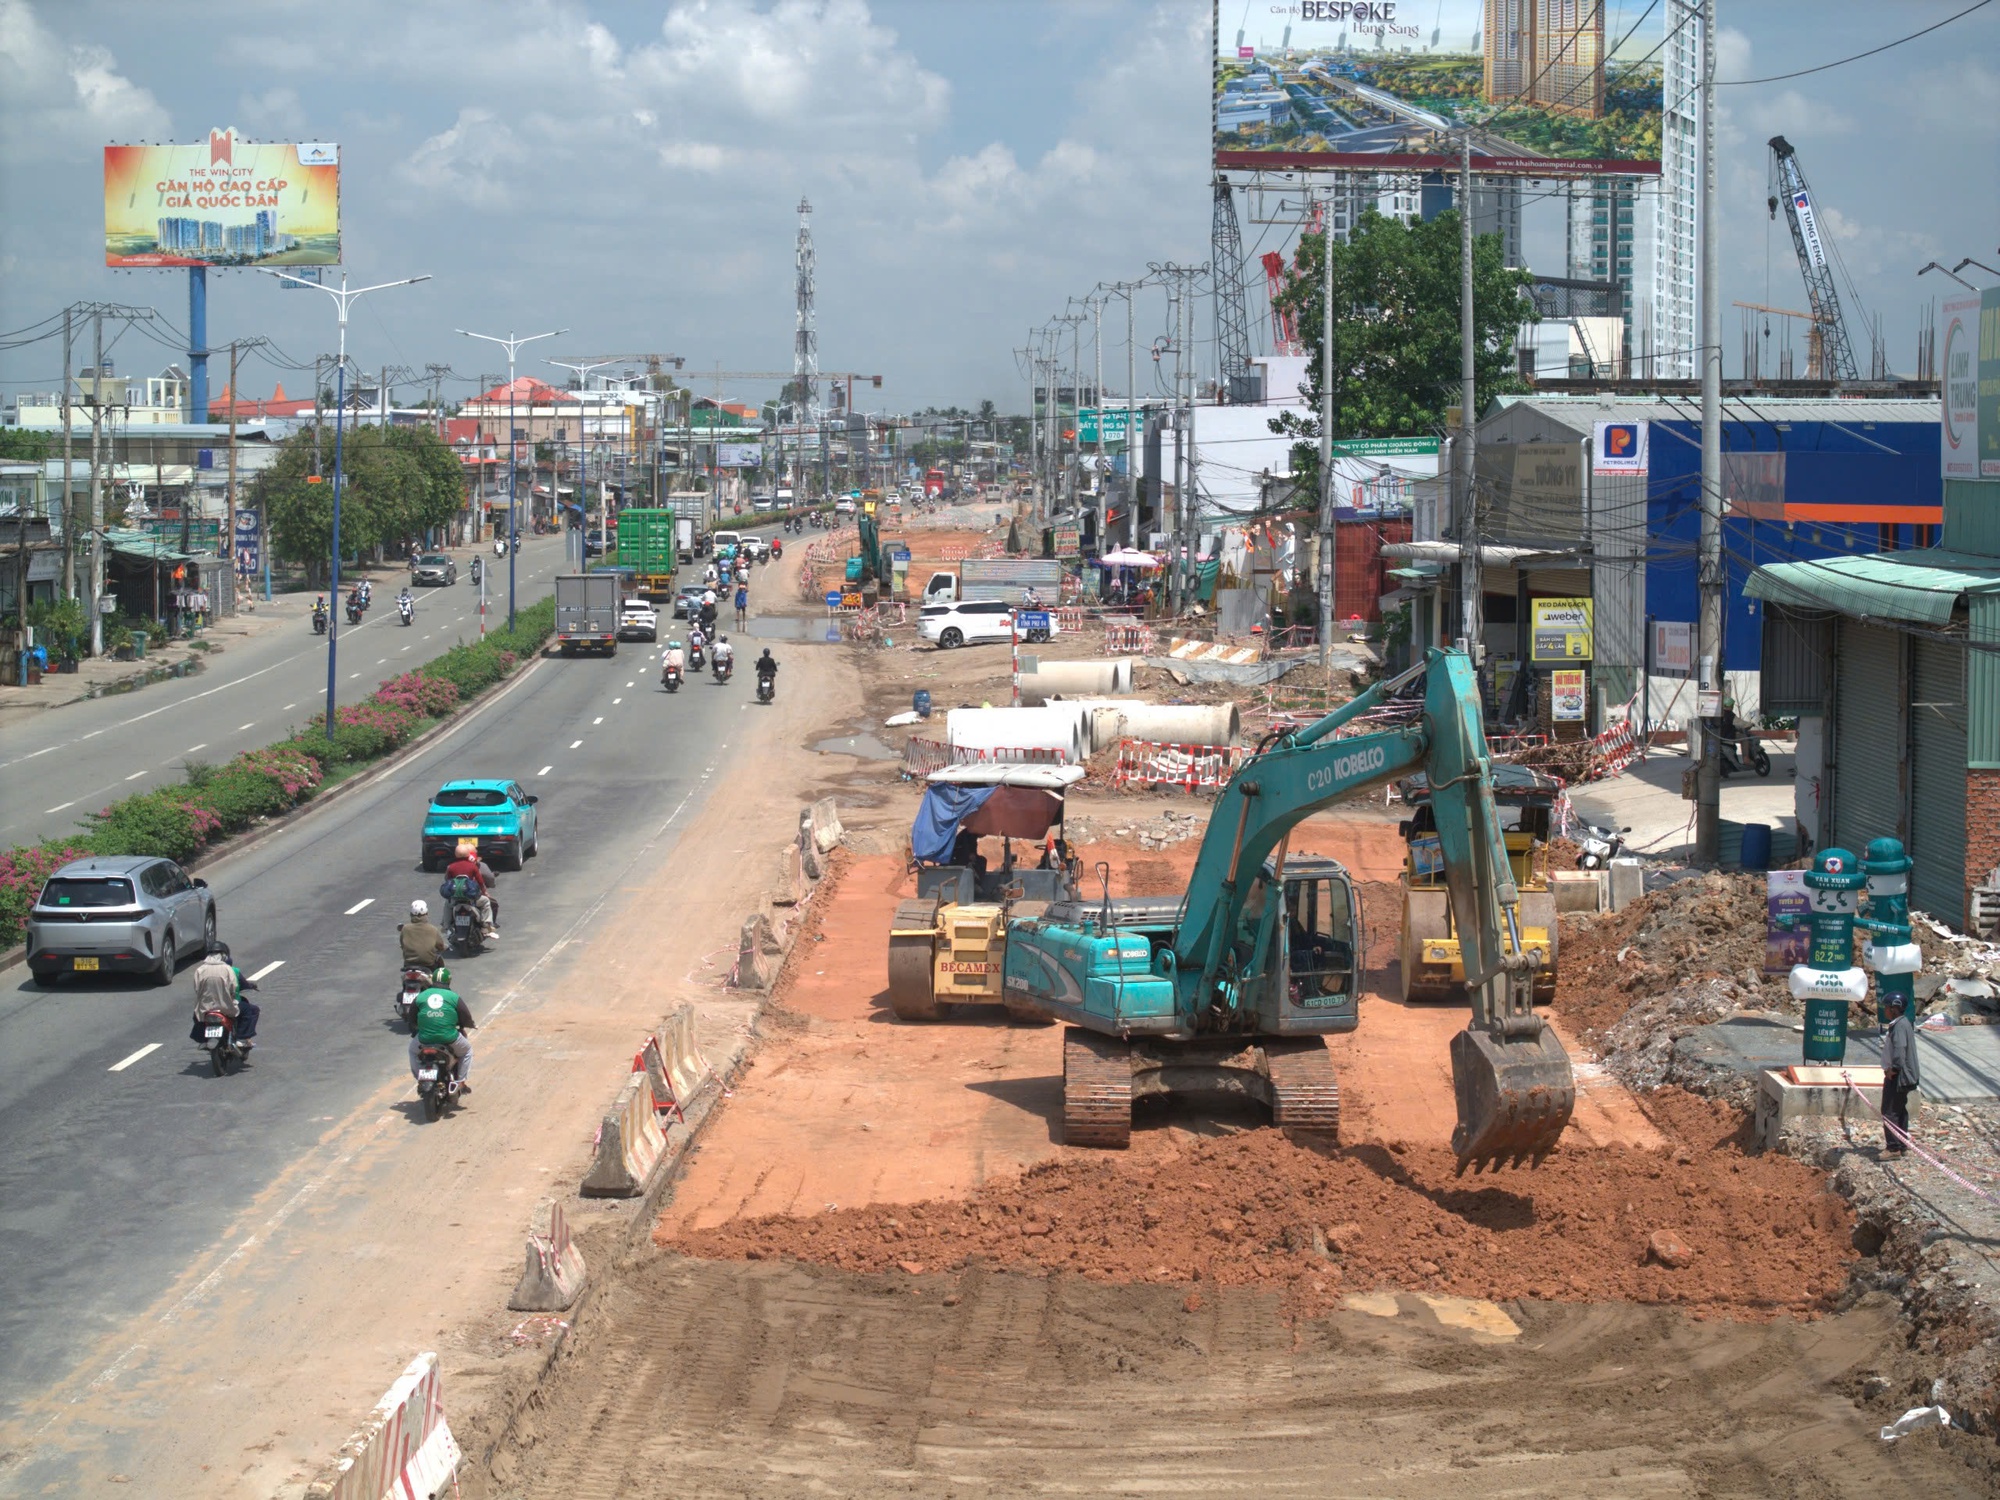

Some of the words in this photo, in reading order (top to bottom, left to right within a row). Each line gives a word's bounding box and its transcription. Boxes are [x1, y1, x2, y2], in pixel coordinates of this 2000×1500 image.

[1270, 5, 1287, 14] Căn
[1302, 0, 1396, 21] BESPOKE
[1353, 22, 1386, 38] Hạng
[1388, 23, 1419, 38] Sang
[189, 168, 206, 176] THE
[210, 168, 229, 176] WIN
[232, 168, 254, 176] CITY
[156, 179, 188, 193] CĂN
[193, 179, 216, 195] HỘ
[219, 180, 252, 192] CAO
[255, 177, 288, 192] CẤP
[166, 193, 192, 207] GIÁ
[196, 193, 241, 209] QUỐC
[245, 194, 278, 207] DÂN
[1803, 210, 1817, 239] TUNG
[1810, 239, 1824, 265] FENG
[1951, 352, 1970, 379] LINH
[1950, 381, 1977, 409] TRUNG
[1551, 612, 1583, 621] weber
[1547, 642, 1555, 651] 4
[1308, 767, 1332, 791] C20
[1334, 747, 1385, 781] KOBELCO
[1122, 950, 1148, 958] KOBELCO
[1815, 951, 1833, 963] 62.2
[940, 962, 1000, 974] BECAMEX
[1006, 977, 1029, 991] SK200
[426, 1009, 445, 1018] Grab
